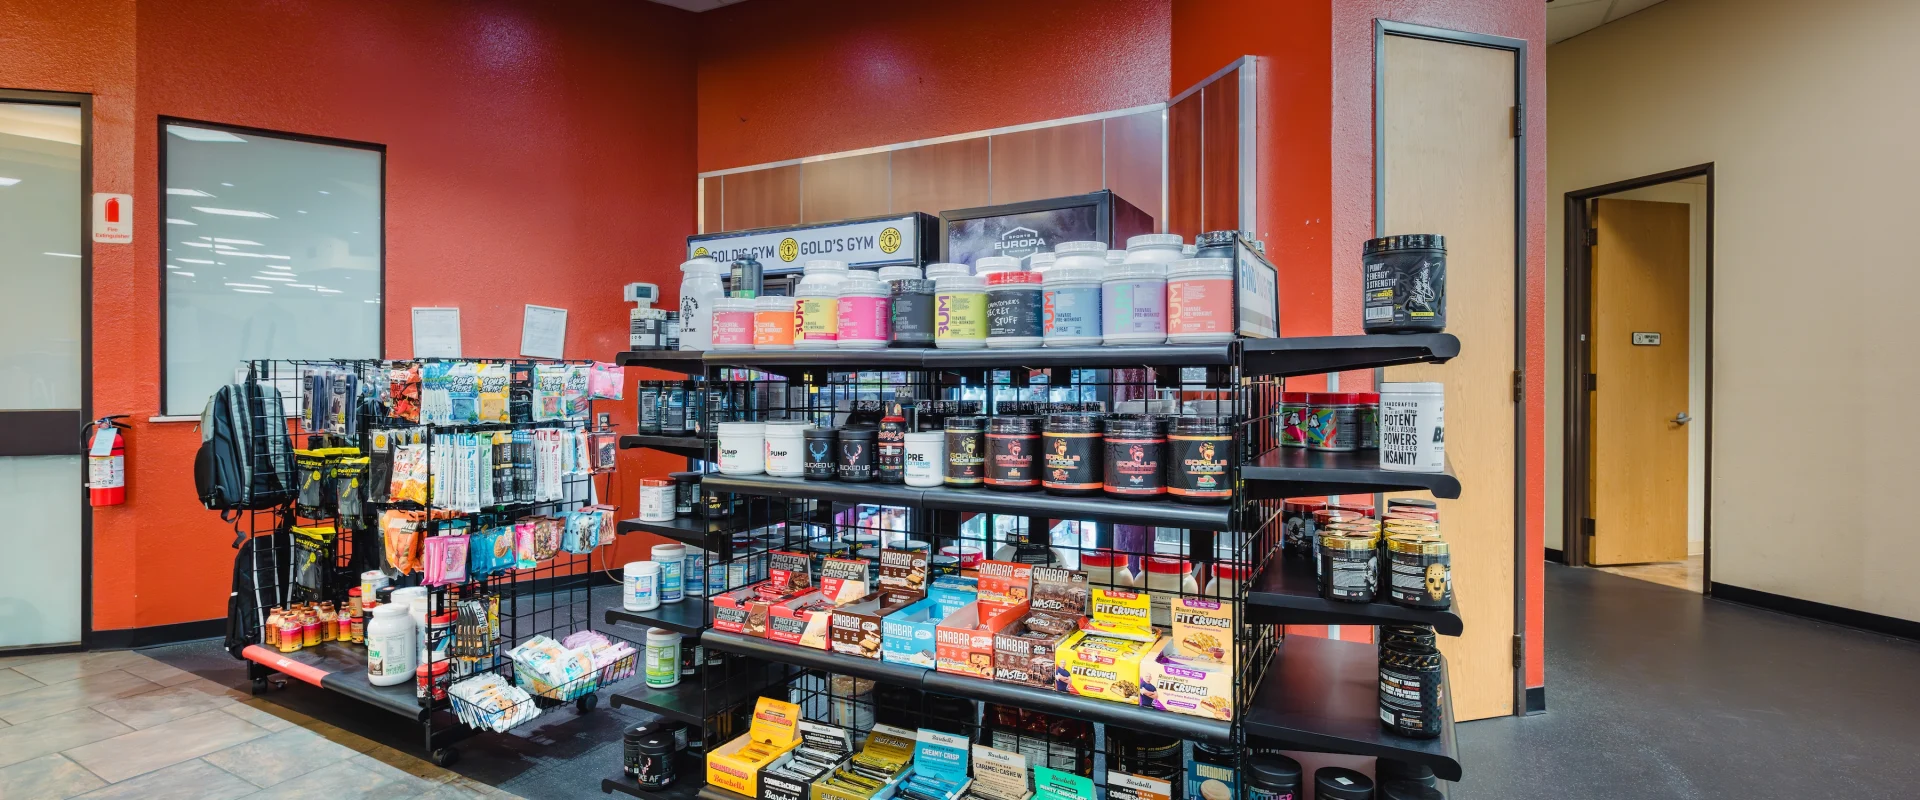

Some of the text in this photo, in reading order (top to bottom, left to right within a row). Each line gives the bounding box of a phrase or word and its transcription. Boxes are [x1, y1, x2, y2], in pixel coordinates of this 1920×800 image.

[801, 235, 874, 256] GOLD'S GYM
[994, 237, 1046, 250] EUROPA
[711, 247, 748, 263] GOLD'S
[751, 245, 775, 260] GYM
[986, 306, 1010, 318] SECRET
[1043, 291, 1055, 336] BUM
[1114, 284, 1133, 333] BUM
[1169, 283, 1182, 332] BUM
[938, 295, 950, 337] BUM
[994, 316, 1018, 327] STUFF
[452, 376, 474, 386] SOUR
[481, 376, 506, 386] SOUR
[450, 384, 473, 393] STRIPS
[479, 384, 503, 394] STRIPS
[1384, 413, 1418, 427] POTENT
[1384, 432, 1418, 446] POWERS
[907, 453, 924, 462] PRE
[1383, 450, 1417, 466] INSANITY
[771, 553, 808, 566] PROTEIN
[881, 551, 912, 566] ANABAR
[769, 561, 794, 572] CRISP
[821, 568, 849, 579] CRISP
[824, 560, 866, 573] PROTEIN
[980, 562, 1014, 578] ANABAR
[1033, 567, 1070, 583] ANABAR
[1031, 599, 1062, 610] WASTED
[1095, 603, 1147, 618] FIT CRUNCH
[716, 612, 736, 622] CRISP
[717, 607, 746, 618] PROTEIN
[772, 623, 793, 632] CRISP
[773, 617, 804, 628] PROTEIN
[832, 613, 861, 629] ANABAR
[1174, 612, 1231, 629] FIT CRUNCH
[883, 621, 913, 638] ANABAR
[937, 629, 970, 646] ANABAR
[995, 635, 1030, 654] ANABAR
[996, 668, 1028, 681] WASTED
[1071, 665, 1117, 681] FIT CRUNCH
[1157, 679, 1208, 696] FIT CRUNCH
[1196, 763, 1232, 783] LEGENDARY
[713, 773, 745, 791] Barebells
[1122, 788, 1143, 796] PROTEIN
